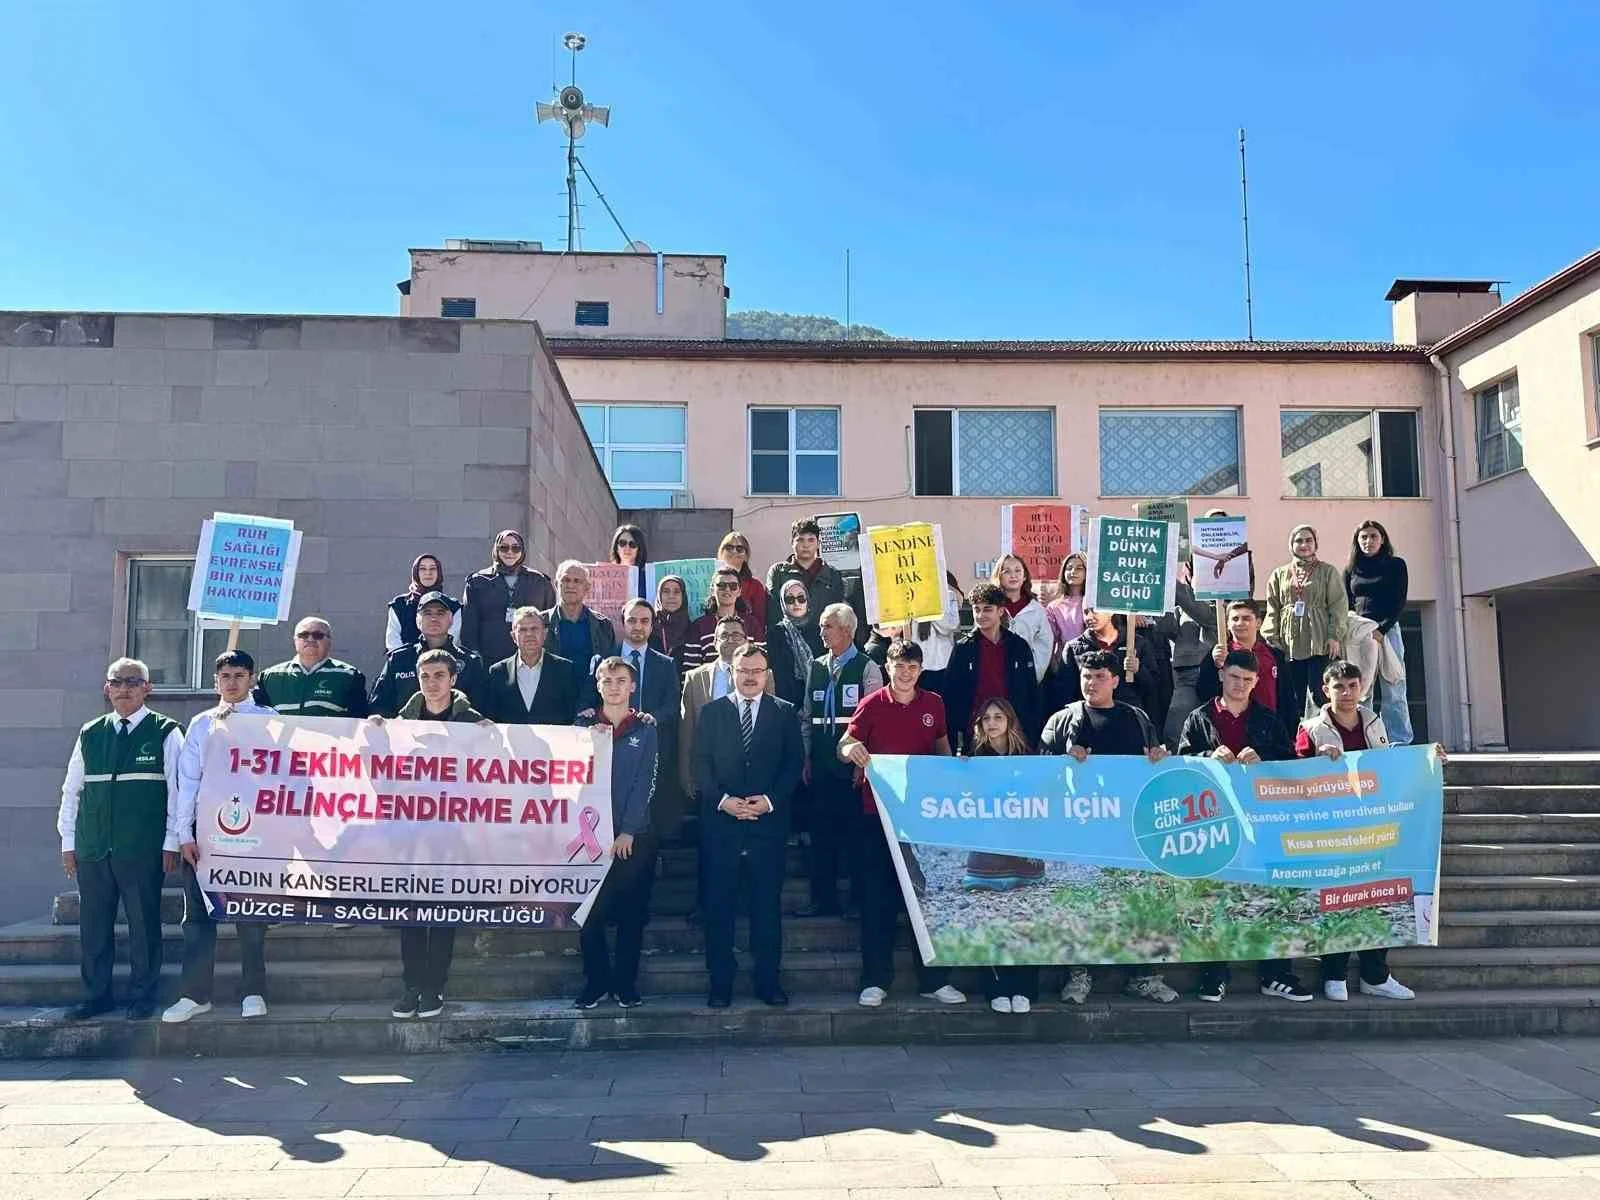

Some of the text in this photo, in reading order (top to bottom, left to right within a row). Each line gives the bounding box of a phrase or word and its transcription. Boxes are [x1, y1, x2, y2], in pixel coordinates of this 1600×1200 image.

[238, 527, 267, 540] RUH
[1107, 525, 1122, 536] 10
[224, 541, 281, 556] SAĞLIĞI
[873, 534, 936, 555] KENDİNE
[1110, 539, 1158, 554] DÜNYA
[209, 555, 284, 572] EVRENSEL
[898, 551, 915, 569] İYİ
[1118, 557, 1146, 569] RUH
[895, 571, 922, 585] BAK
[1103, 571, 1161, 585] SAĞLIĞI
[207, 586, 279, 603] HAKKIDIR
[1110, 587, 1150, 600] GÜNÜ
[230, 747, 594, 784] 1-31 EKİM MEME KANSERİ
[1259, 781, 1304, 796] Düzenli
[1306, 779, 1351, 798] yürüyüş
[255, 784, 568, 824] BİLİNÇLENDİRME AYI
[920, 791, 1121, 824] SAĞLIĞIN İÇİN
[1154, 789, 1217, 824] HER 10
[1154, 813, 1181, 830] GÜN
[1293, 809, 1329, 824] yerine
[1332, 805, 1385, 820] merdiven
[1286, 839, 1313, 850] Kısa
[1271, 861, 1381, 880] Aracını uzağa park et
[209, 868, 601, 894] KADIN KANSERLERİNE DUR! DİYORUZ
[1325, 884, 1408, 906] Bir durak önce in
[226, 899, 545, 924] DÜZCE İL SAĞLIK MÜDÜRLÜĞÜ
